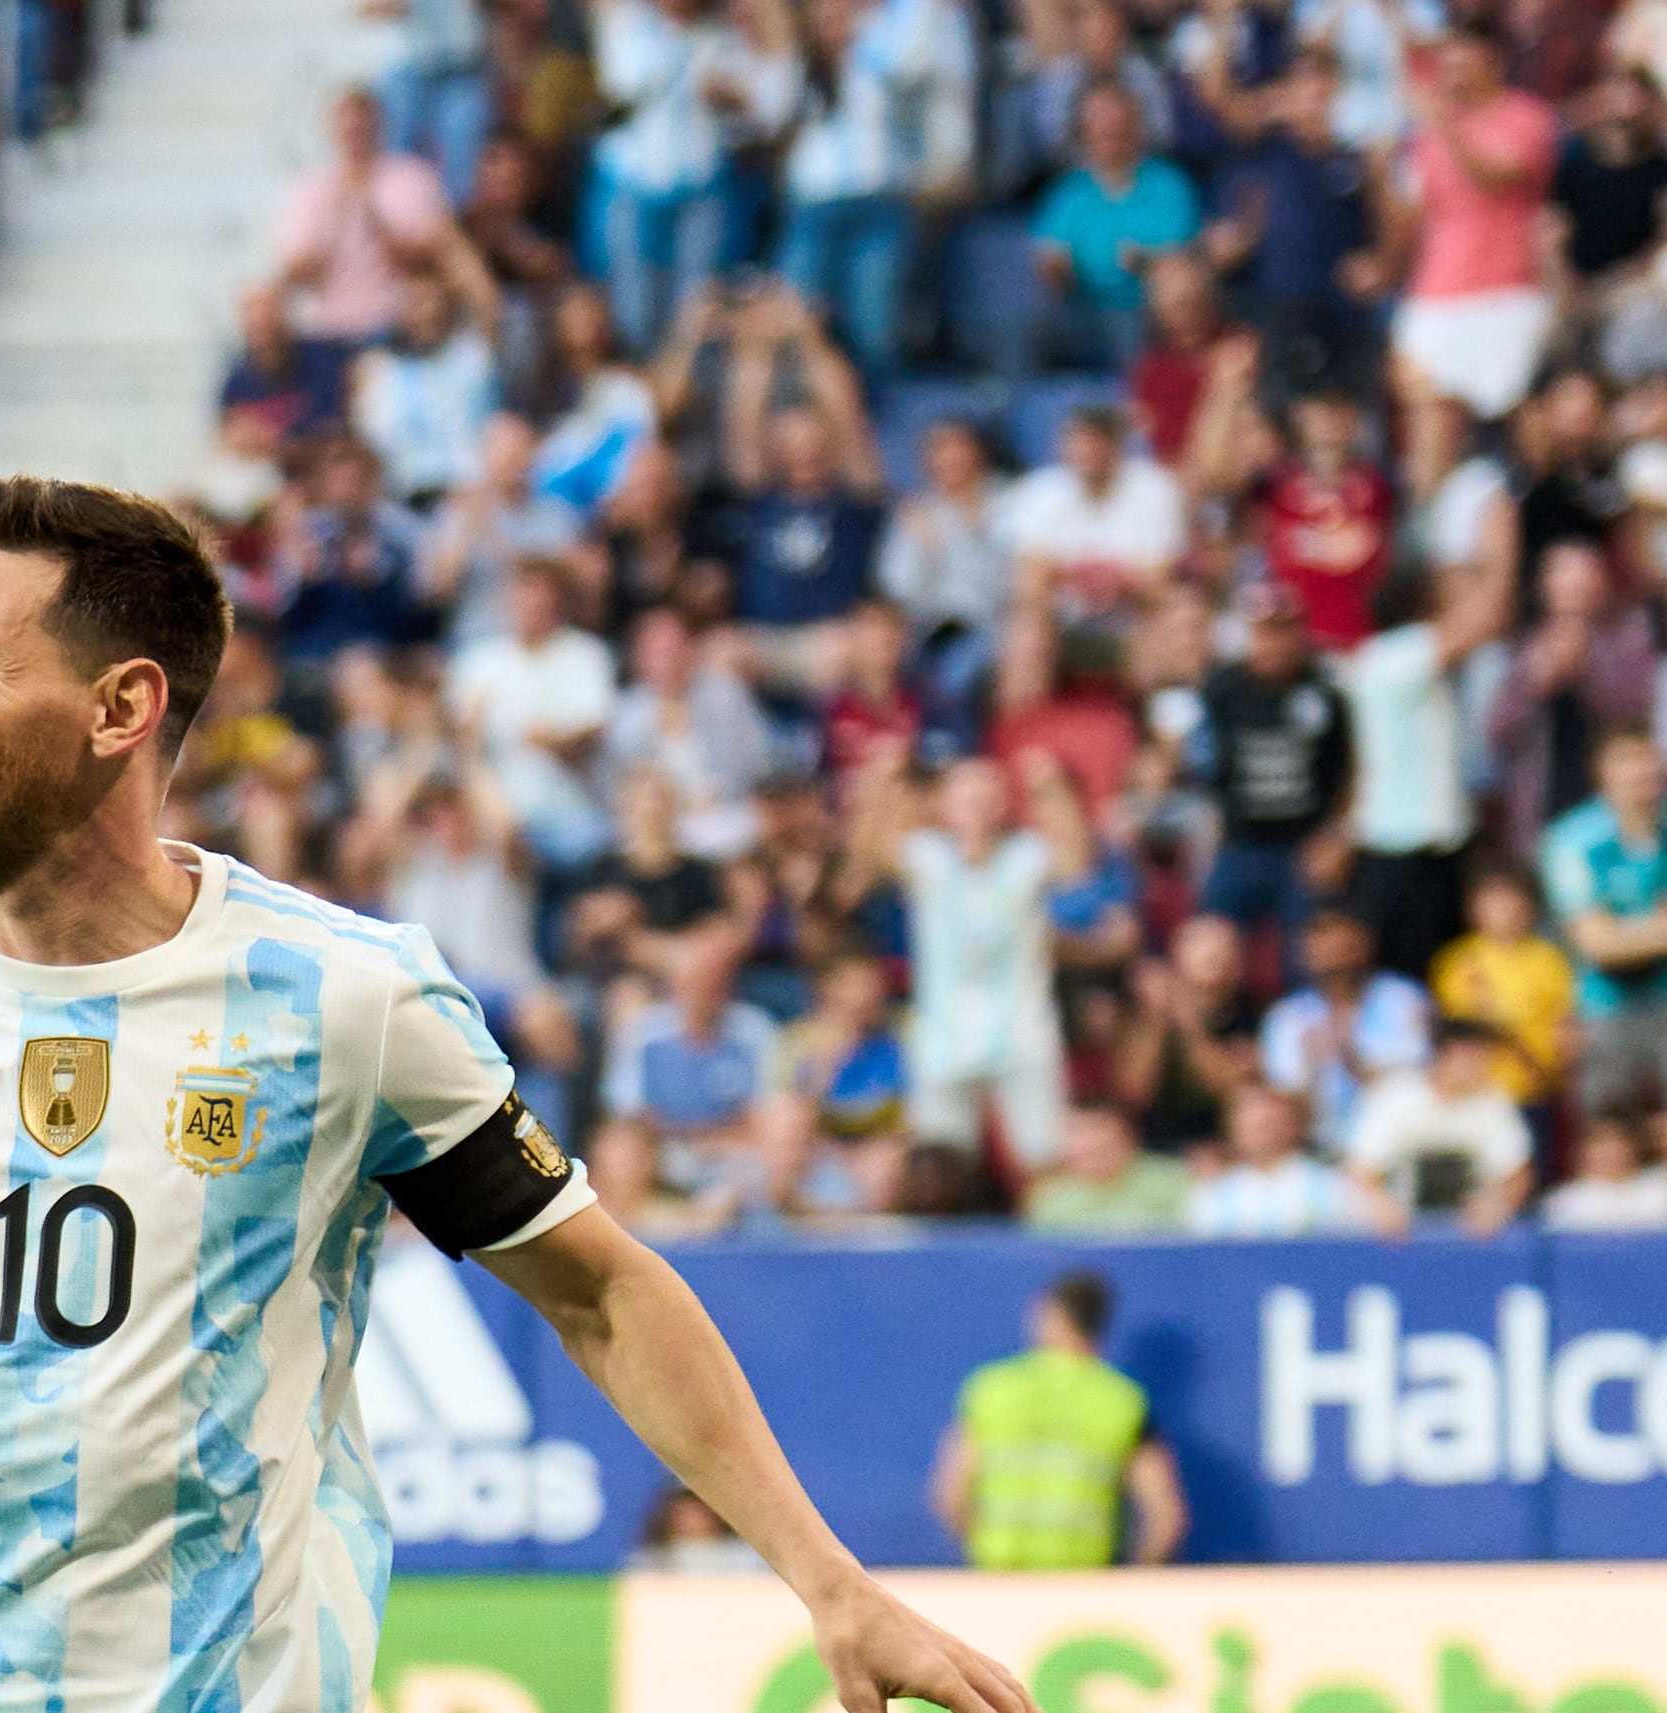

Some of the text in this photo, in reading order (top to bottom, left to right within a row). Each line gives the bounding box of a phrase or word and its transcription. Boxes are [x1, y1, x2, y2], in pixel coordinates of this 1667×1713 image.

[186, 1096, 238, 1147] AFA
[1260, 1282, 1667, 1487] Halc
[379, 1437, 606, 1545] das
